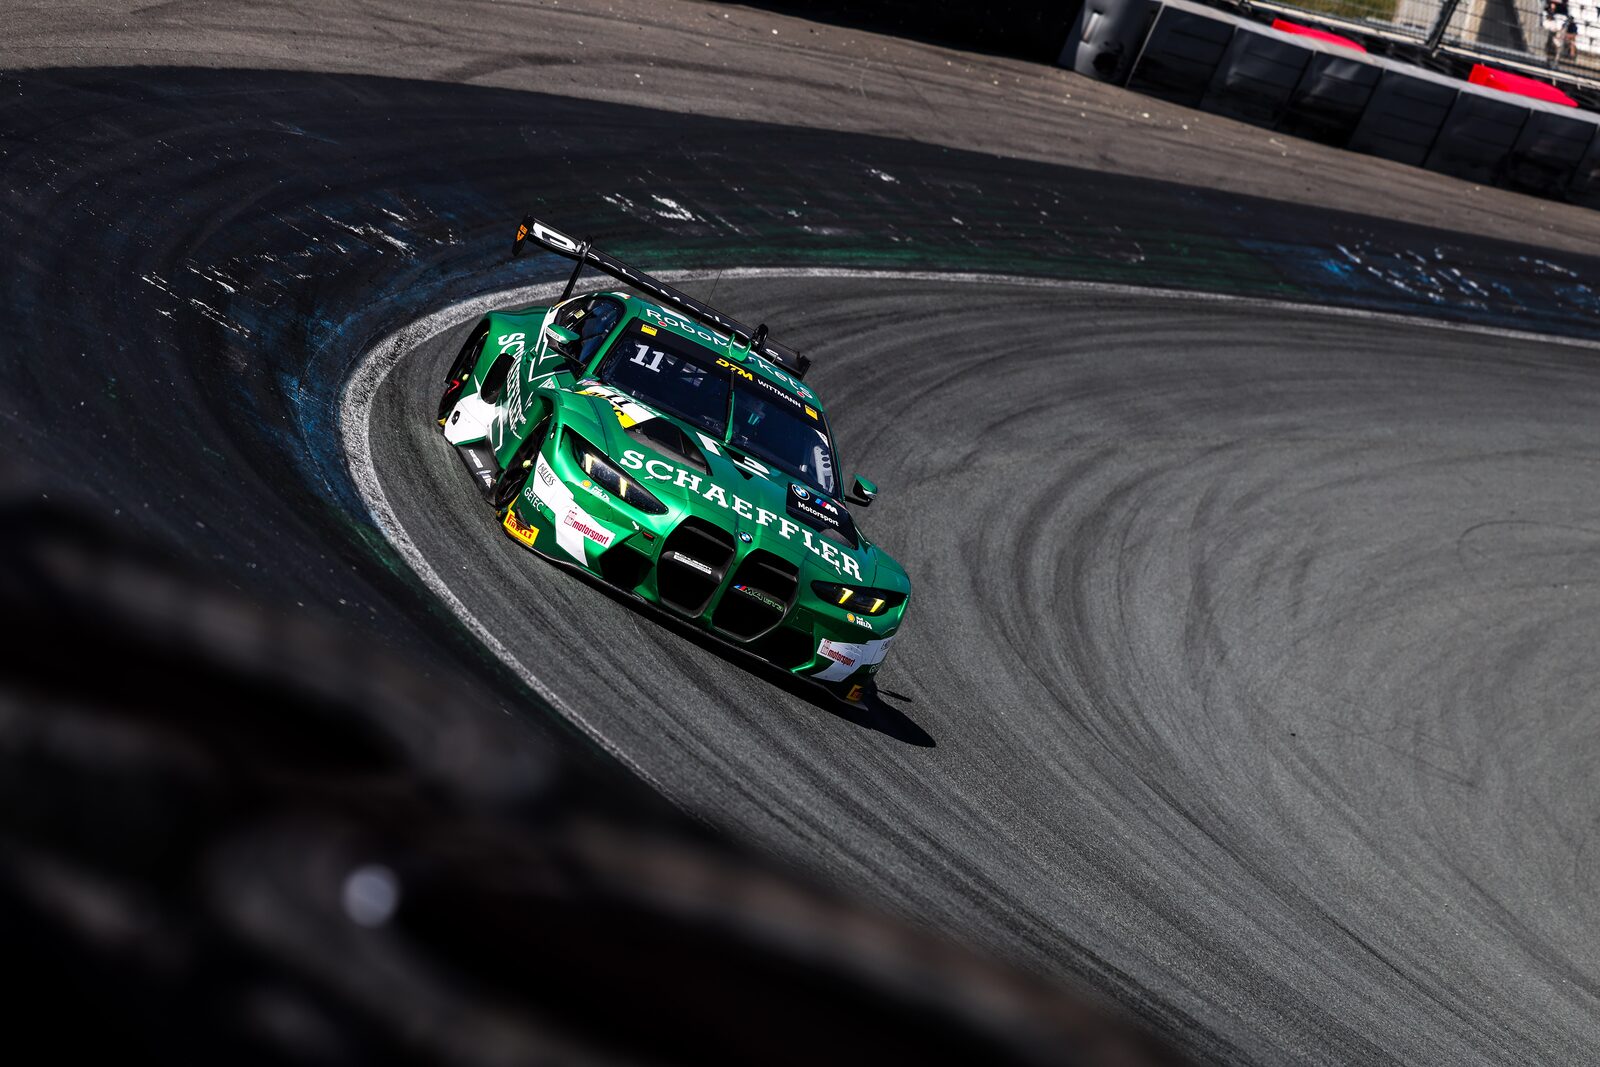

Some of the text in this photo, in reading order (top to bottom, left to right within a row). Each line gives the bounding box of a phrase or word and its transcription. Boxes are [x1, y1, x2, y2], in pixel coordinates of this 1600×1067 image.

[630, 343, 664, 373] 11
[646, 308, 813, 399] RoboMrkets
[716, 358, 801, 408] DTM WITTMANN
[524, 486, 545, 512] GETEC
[620, 449, 863, 582] SCHAEFFLER
[797, 501, 839, 527] Motorsport
[571, 521, 609, 545] motorsport
[827, 649, 856, 667] motorsport
